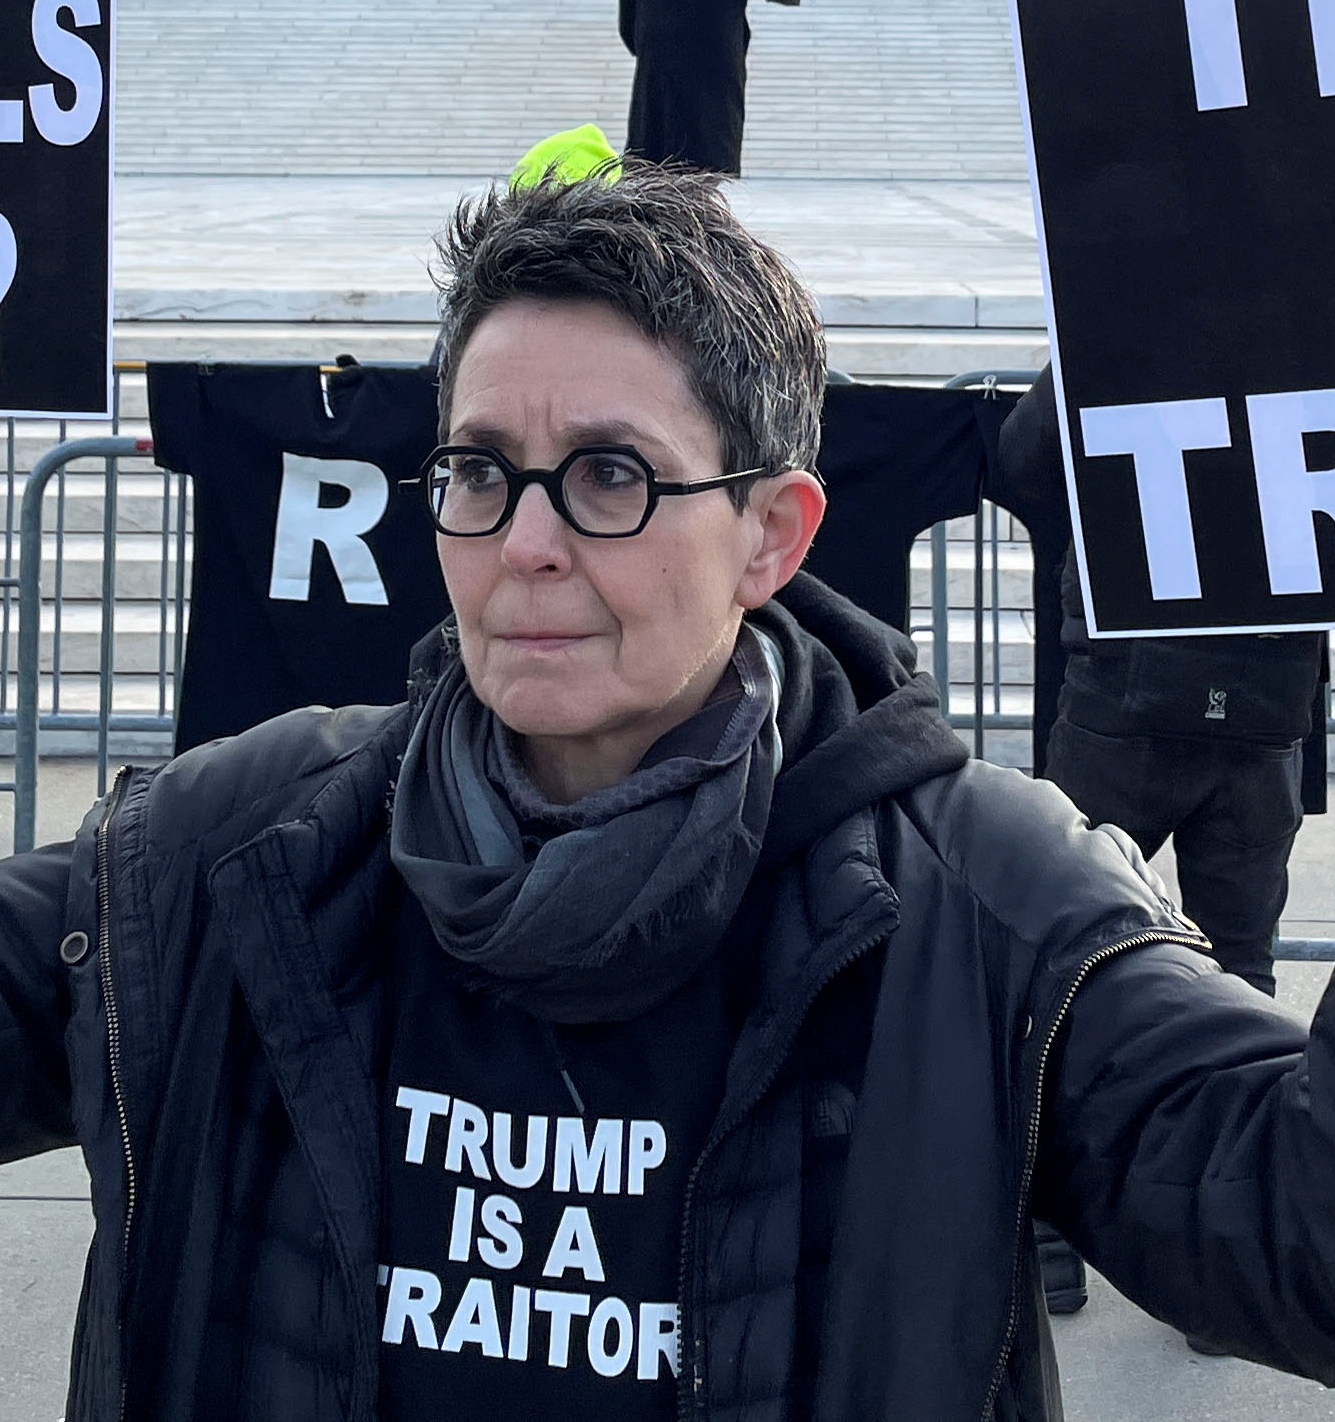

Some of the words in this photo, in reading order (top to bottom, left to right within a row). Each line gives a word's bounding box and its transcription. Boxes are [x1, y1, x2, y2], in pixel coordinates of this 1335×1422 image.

[268, 451, 389, 606] R
[395, 1086, 667, 1196] TRUMP
[448, 1186, 524, 1270] IS
[541, 1205, 606, 1283] A
[377, 1265, 680, 1381] RAITOR
